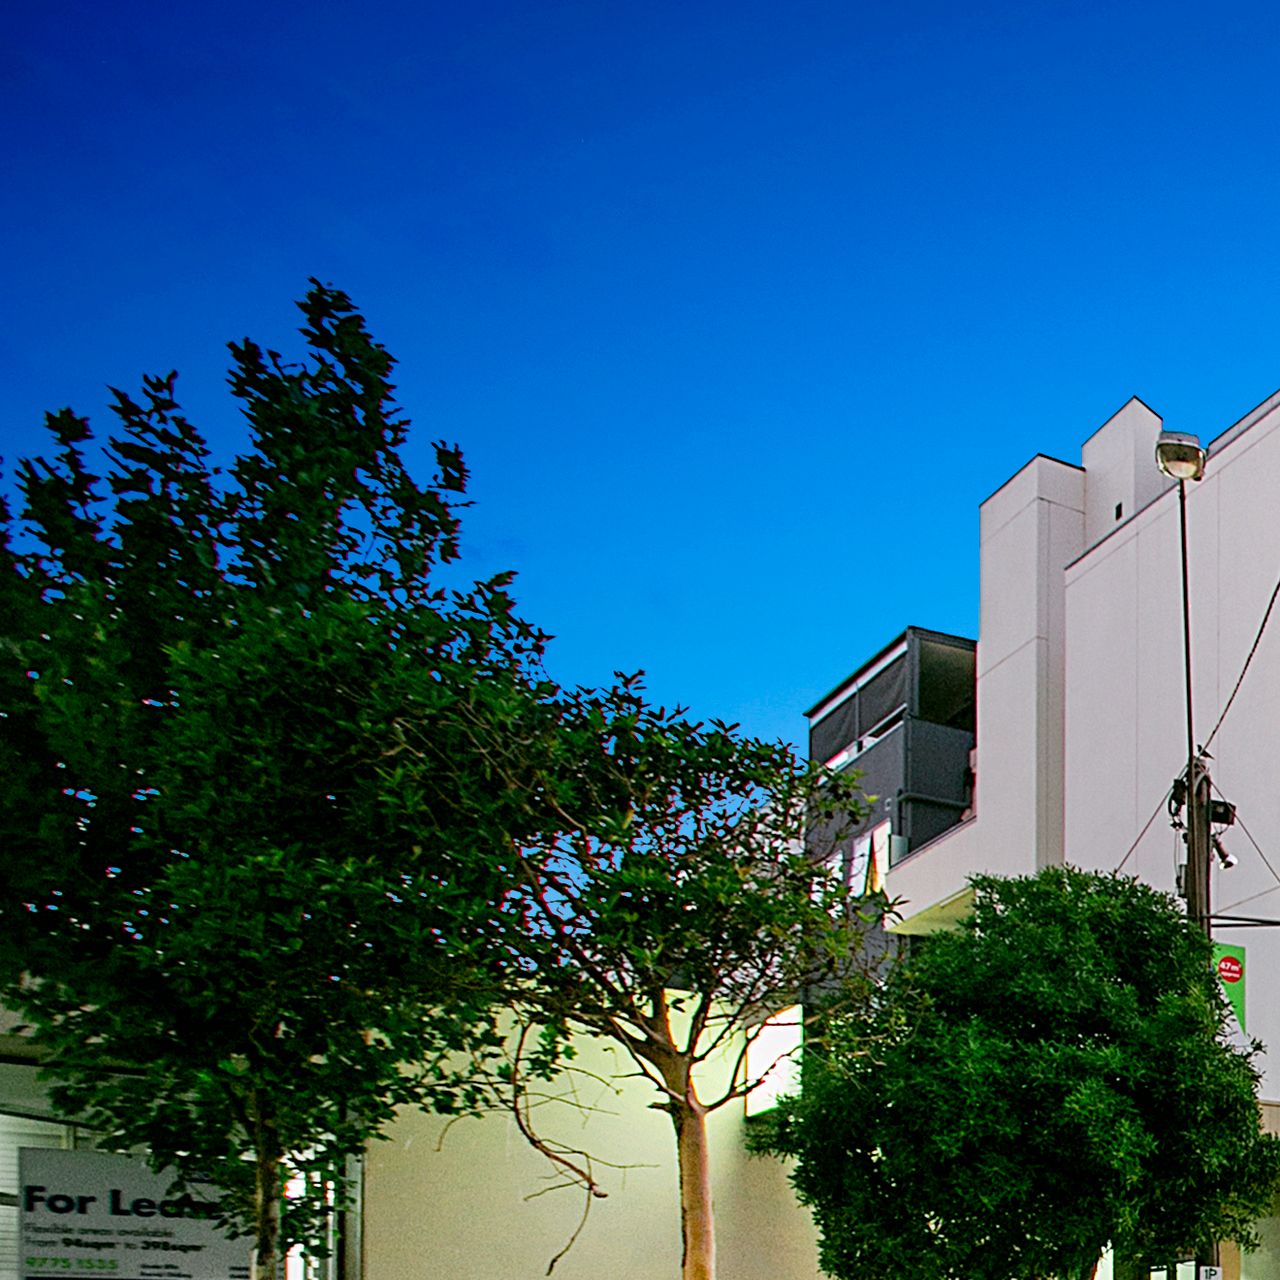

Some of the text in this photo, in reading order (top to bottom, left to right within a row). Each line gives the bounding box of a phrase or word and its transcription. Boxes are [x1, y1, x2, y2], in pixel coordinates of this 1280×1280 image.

[24, 1185, 225, 1220] For Lea
[26, 1256, 72, 1270] 9775
[1204, 1267, 1217, 1280] 1P
